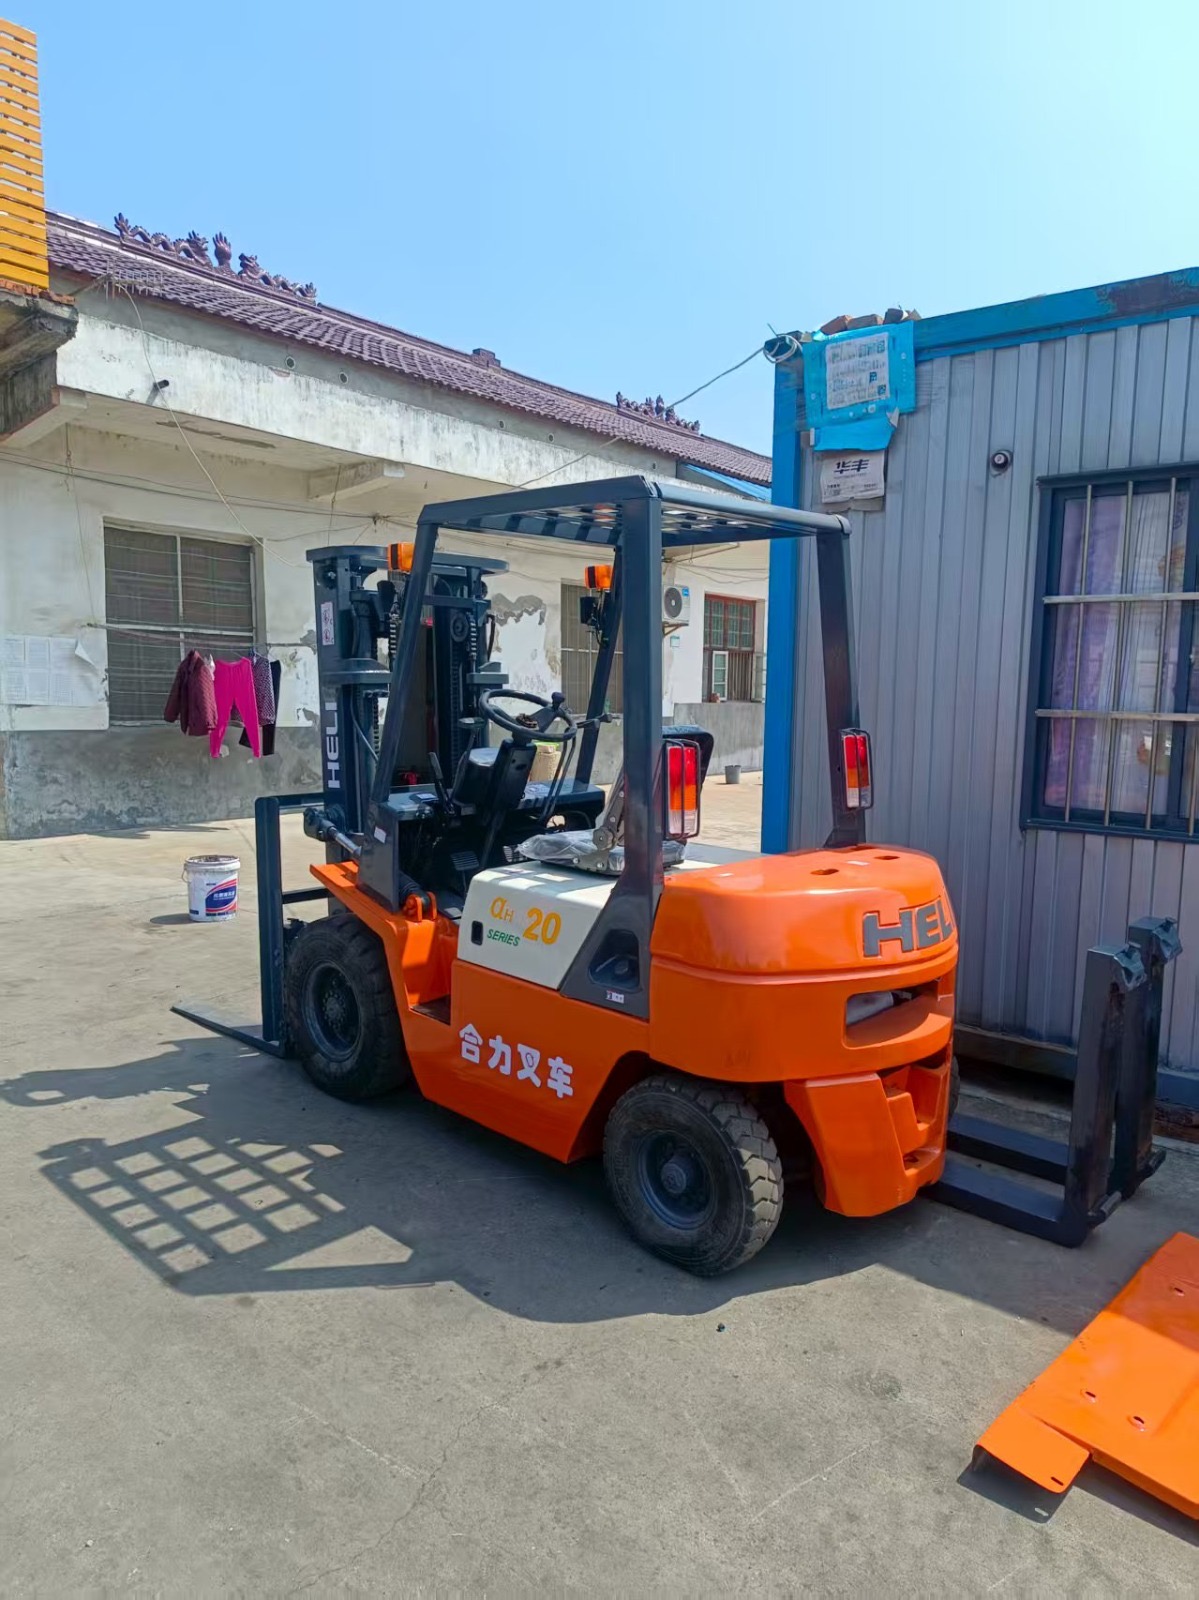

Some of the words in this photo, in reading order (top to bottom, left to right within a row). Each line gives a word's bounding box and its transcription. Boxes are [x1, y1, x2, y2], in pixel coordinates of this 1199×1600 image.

[833, 459, 869, 474] 华丰
[325, 701, 341, 789] HELI
[486, 928, 521, 947] SERIES
[522, 907, 562, 945] 20
[862, 899, 954, 958] HEL
[459, 1023, 574, 1099] 合力叉车
